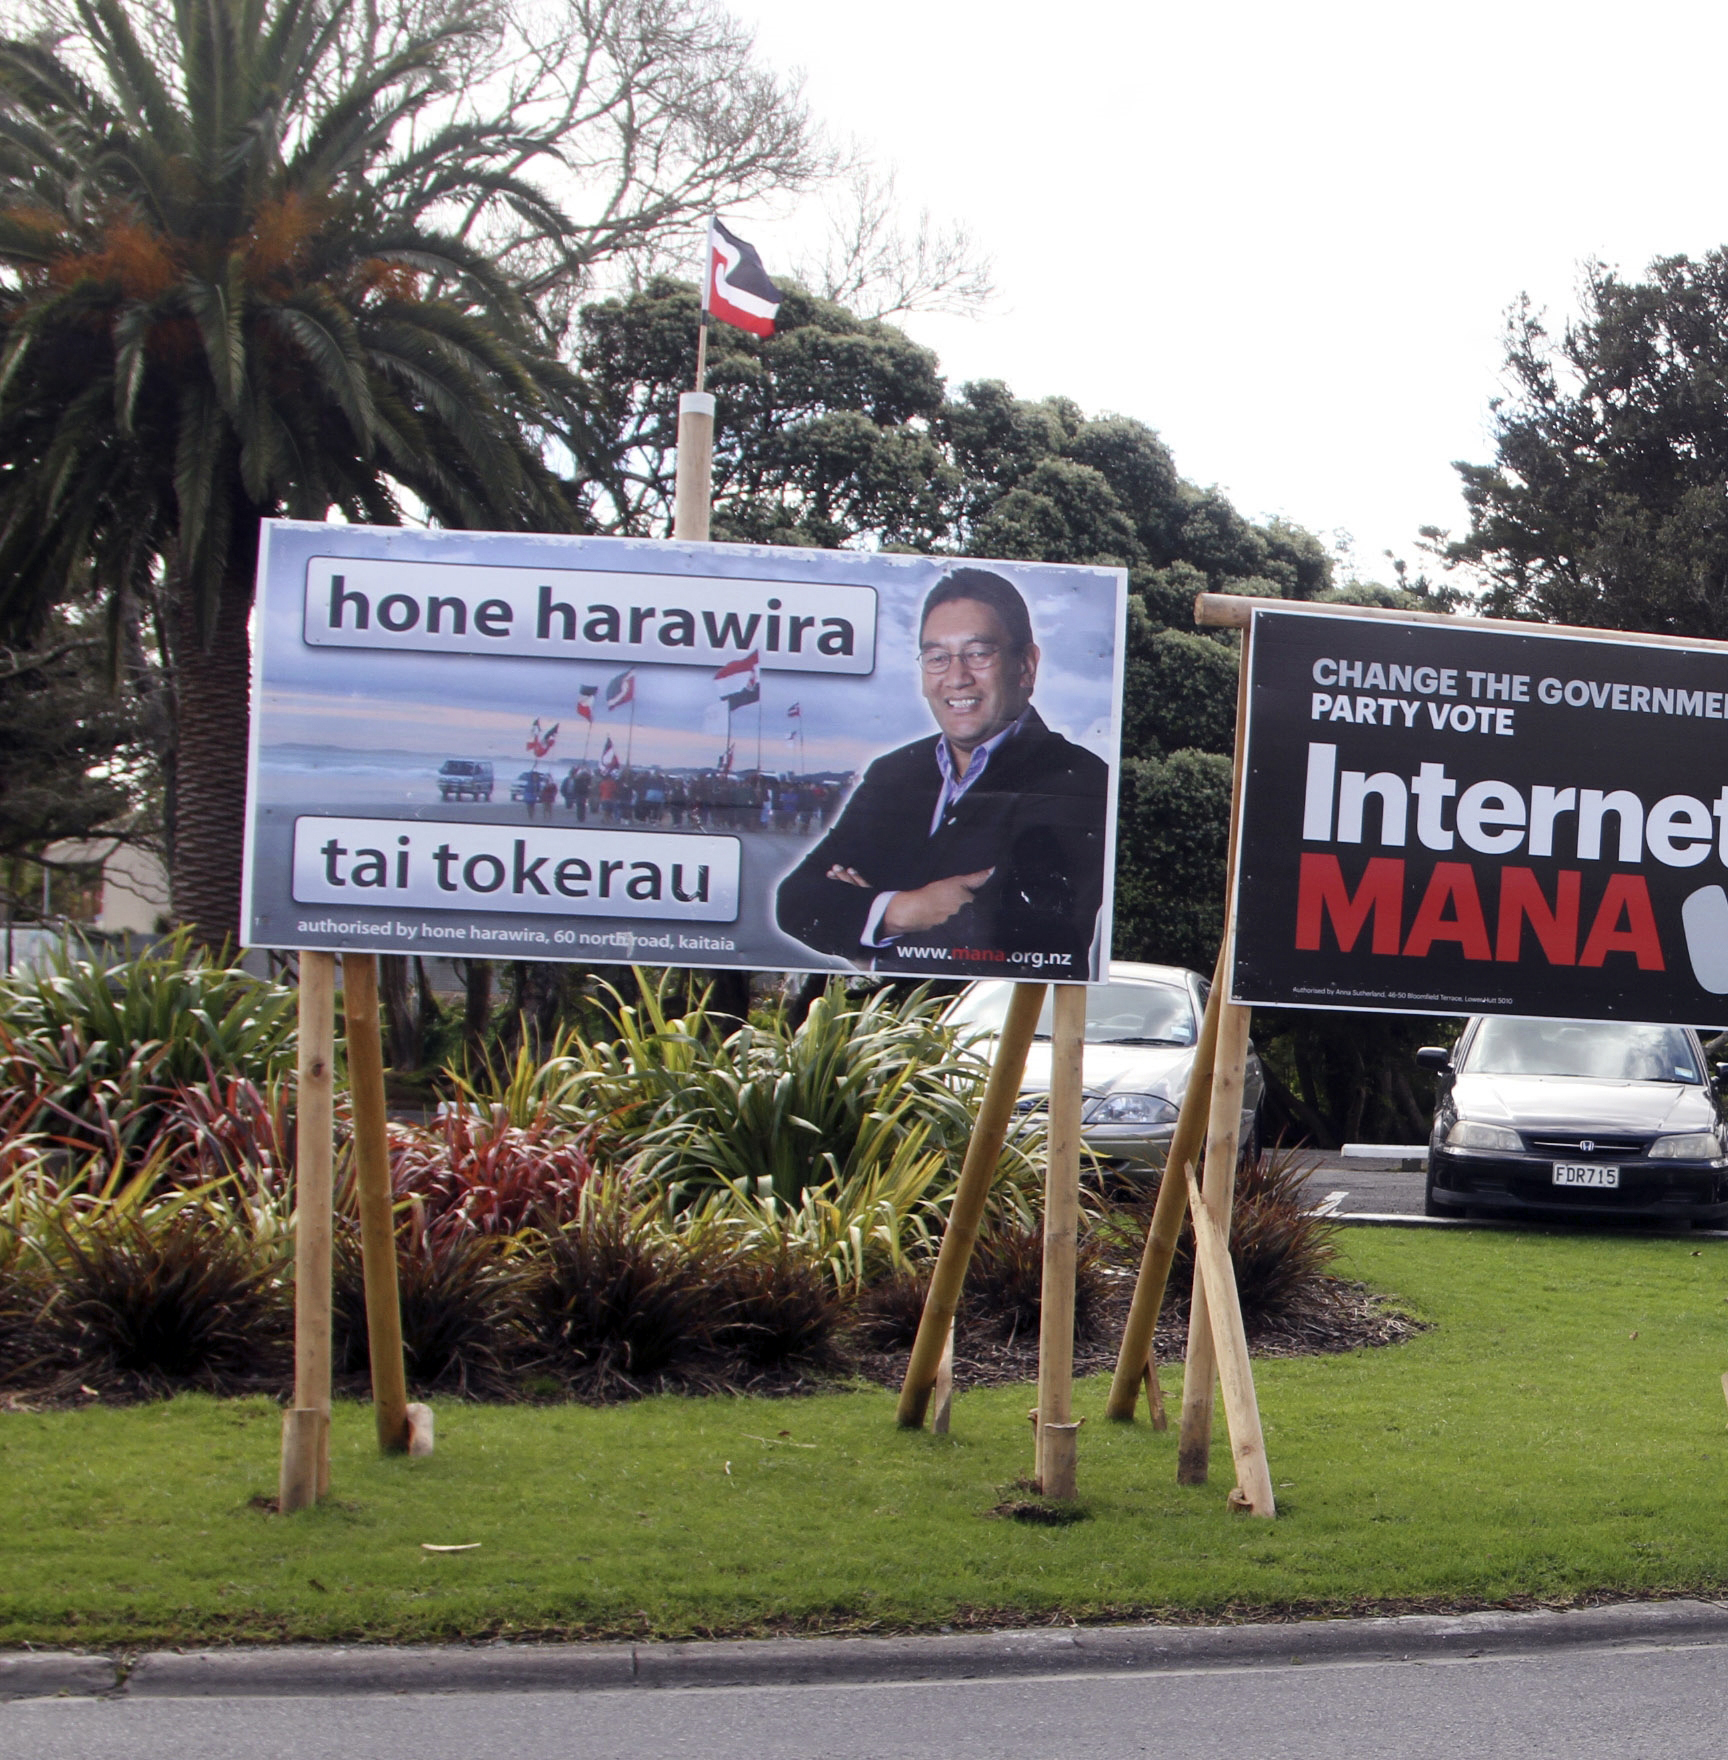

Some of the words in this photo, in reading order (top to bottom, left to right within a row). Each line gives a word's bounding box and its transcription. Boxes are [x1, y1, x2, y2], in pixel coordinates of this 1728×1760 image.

[328, 575, 513, 637] hone
[535, 585, 855, 657] harawira
[1312, 658, 1458, 698] CHANGE
[1466, 671, 1530, 703] THE
[1310, 692, 1419, 728] PARTY
[1427, 703, 1515, 736] VOTE
[321, 835, 410, 889] tai
[432, 839, 709, 903] tokerau
[297, 918, 392, 936] authorised
[396, 921, 417, 940] by
[421, 923, 466, 938] hone
[470, 925, 549, 943] harawira,
[553, 929, 576, 943] 60
[579, 931, 632, 946] north
[632, 931, 675, 949] road,
[679, 934, 736, 950] kaitaia
[1295, 852, 1666, 972] MANA
[896, 945, 1073, 968] www.mana.org.nz
[1556, 1166, 1616, 1185] FDR715
